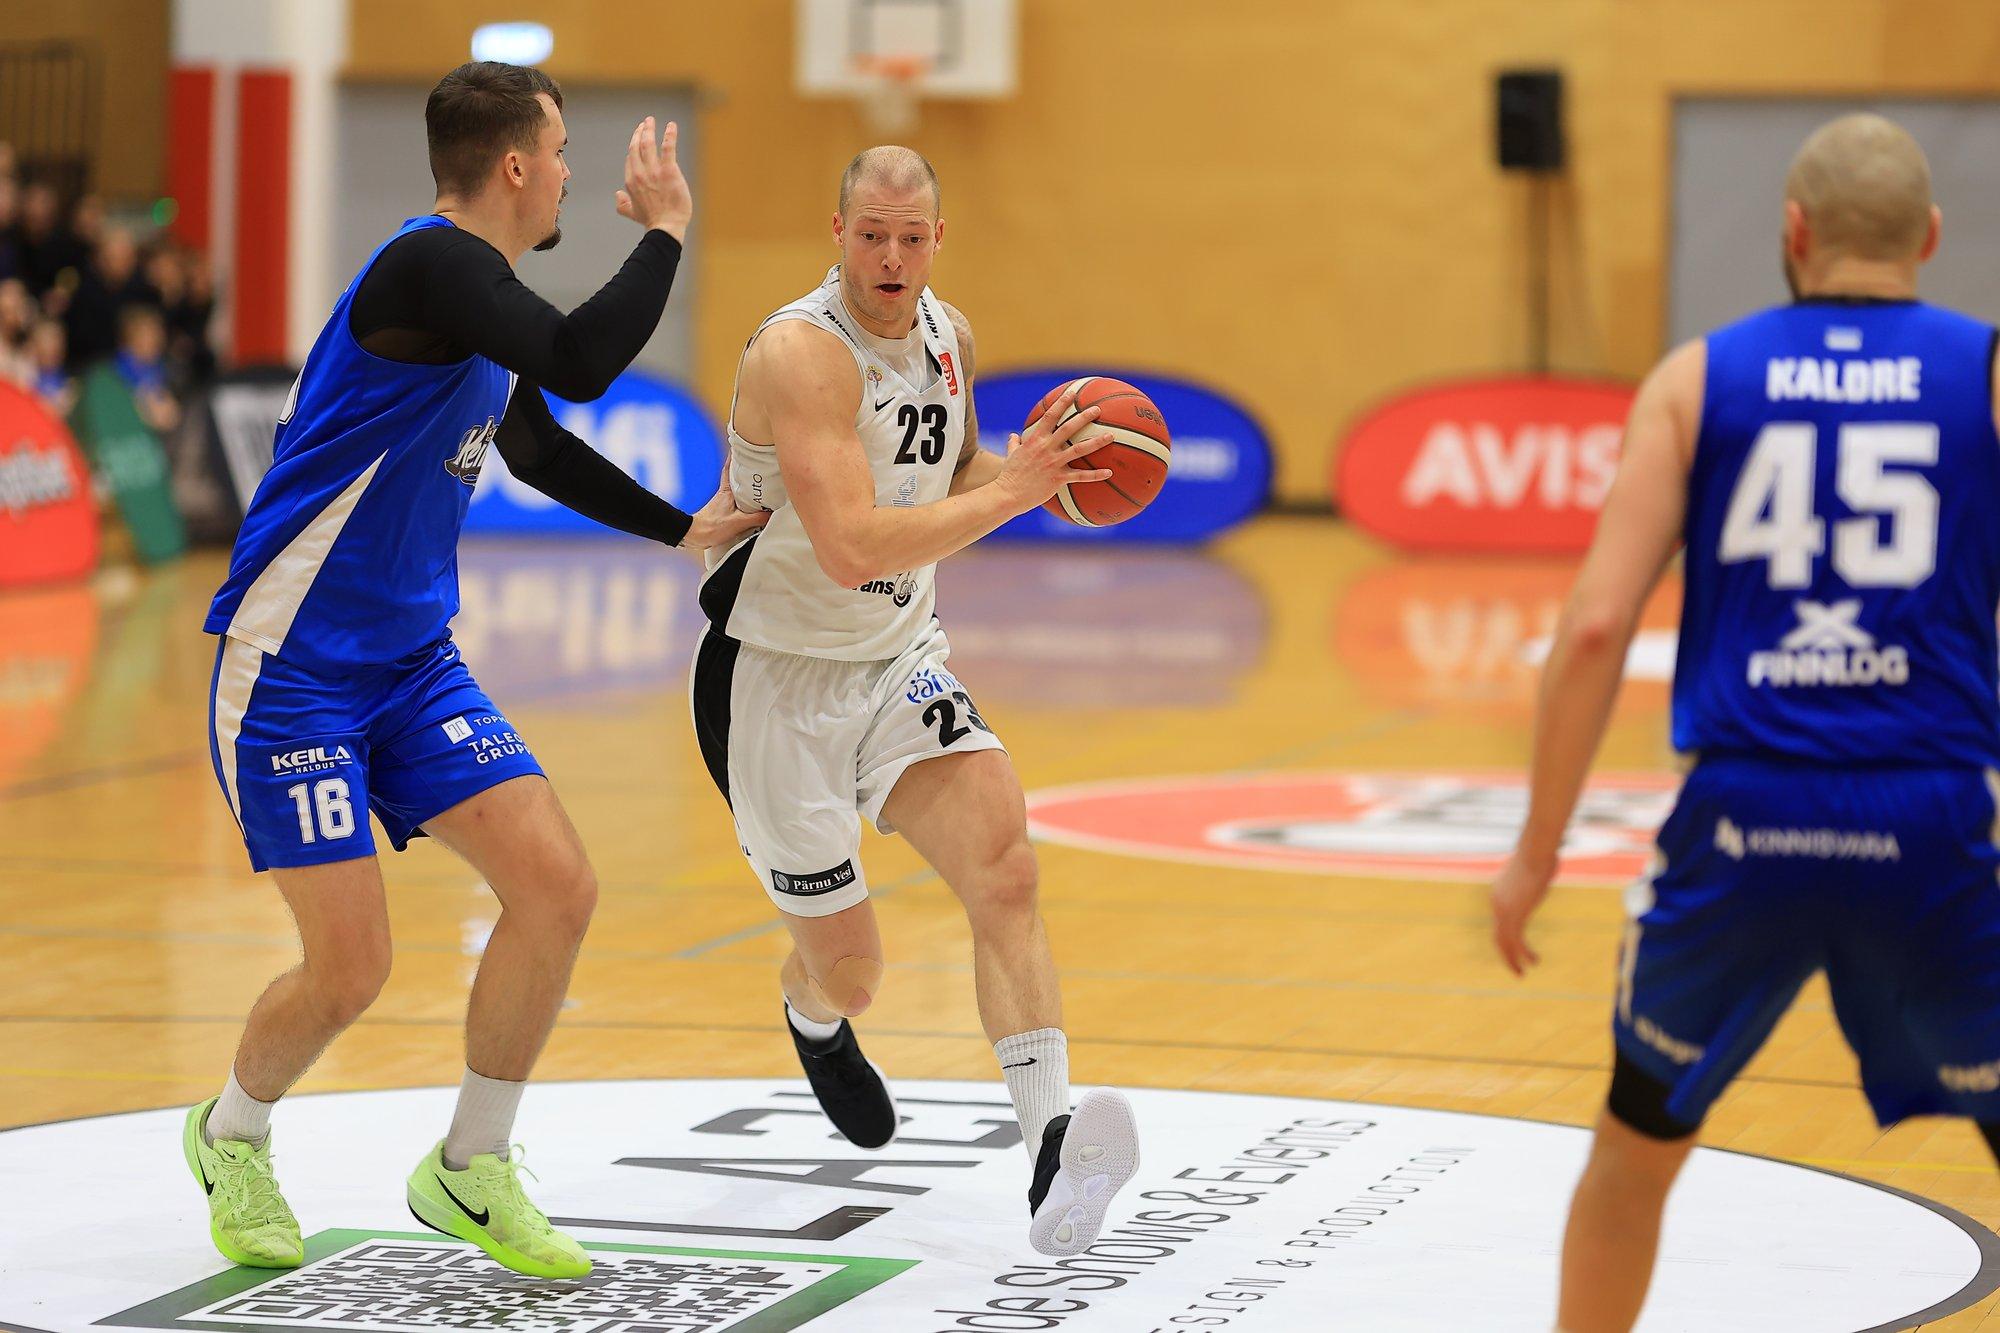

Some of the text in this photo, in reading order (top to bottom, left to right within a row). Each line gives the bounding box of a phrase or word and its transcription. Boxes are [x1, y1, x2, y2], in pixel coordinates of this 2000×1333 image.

[893, 403, 948, 465] 23
[1718, 422, 1941, 591] 45
[1748, 645, 1909, 688] FINNLOG
[922, 691, 993, 748] 23
[272, 745, 351, 771] KEILA
[295, 761, 335, 774] HALDUS
[287, 777, 357, 844] 16
[793, 866, 852, 891] Pärnu Vesi
[1173, 1116, 1379, 1188] Events
[1139, 1189, 1268, 1206] &
[1284, 1146, 1477, 1250] PRODUCTION
[993, 1209, 1229, 1291] Shows
[1256, 1258, 1318, 1269] &
